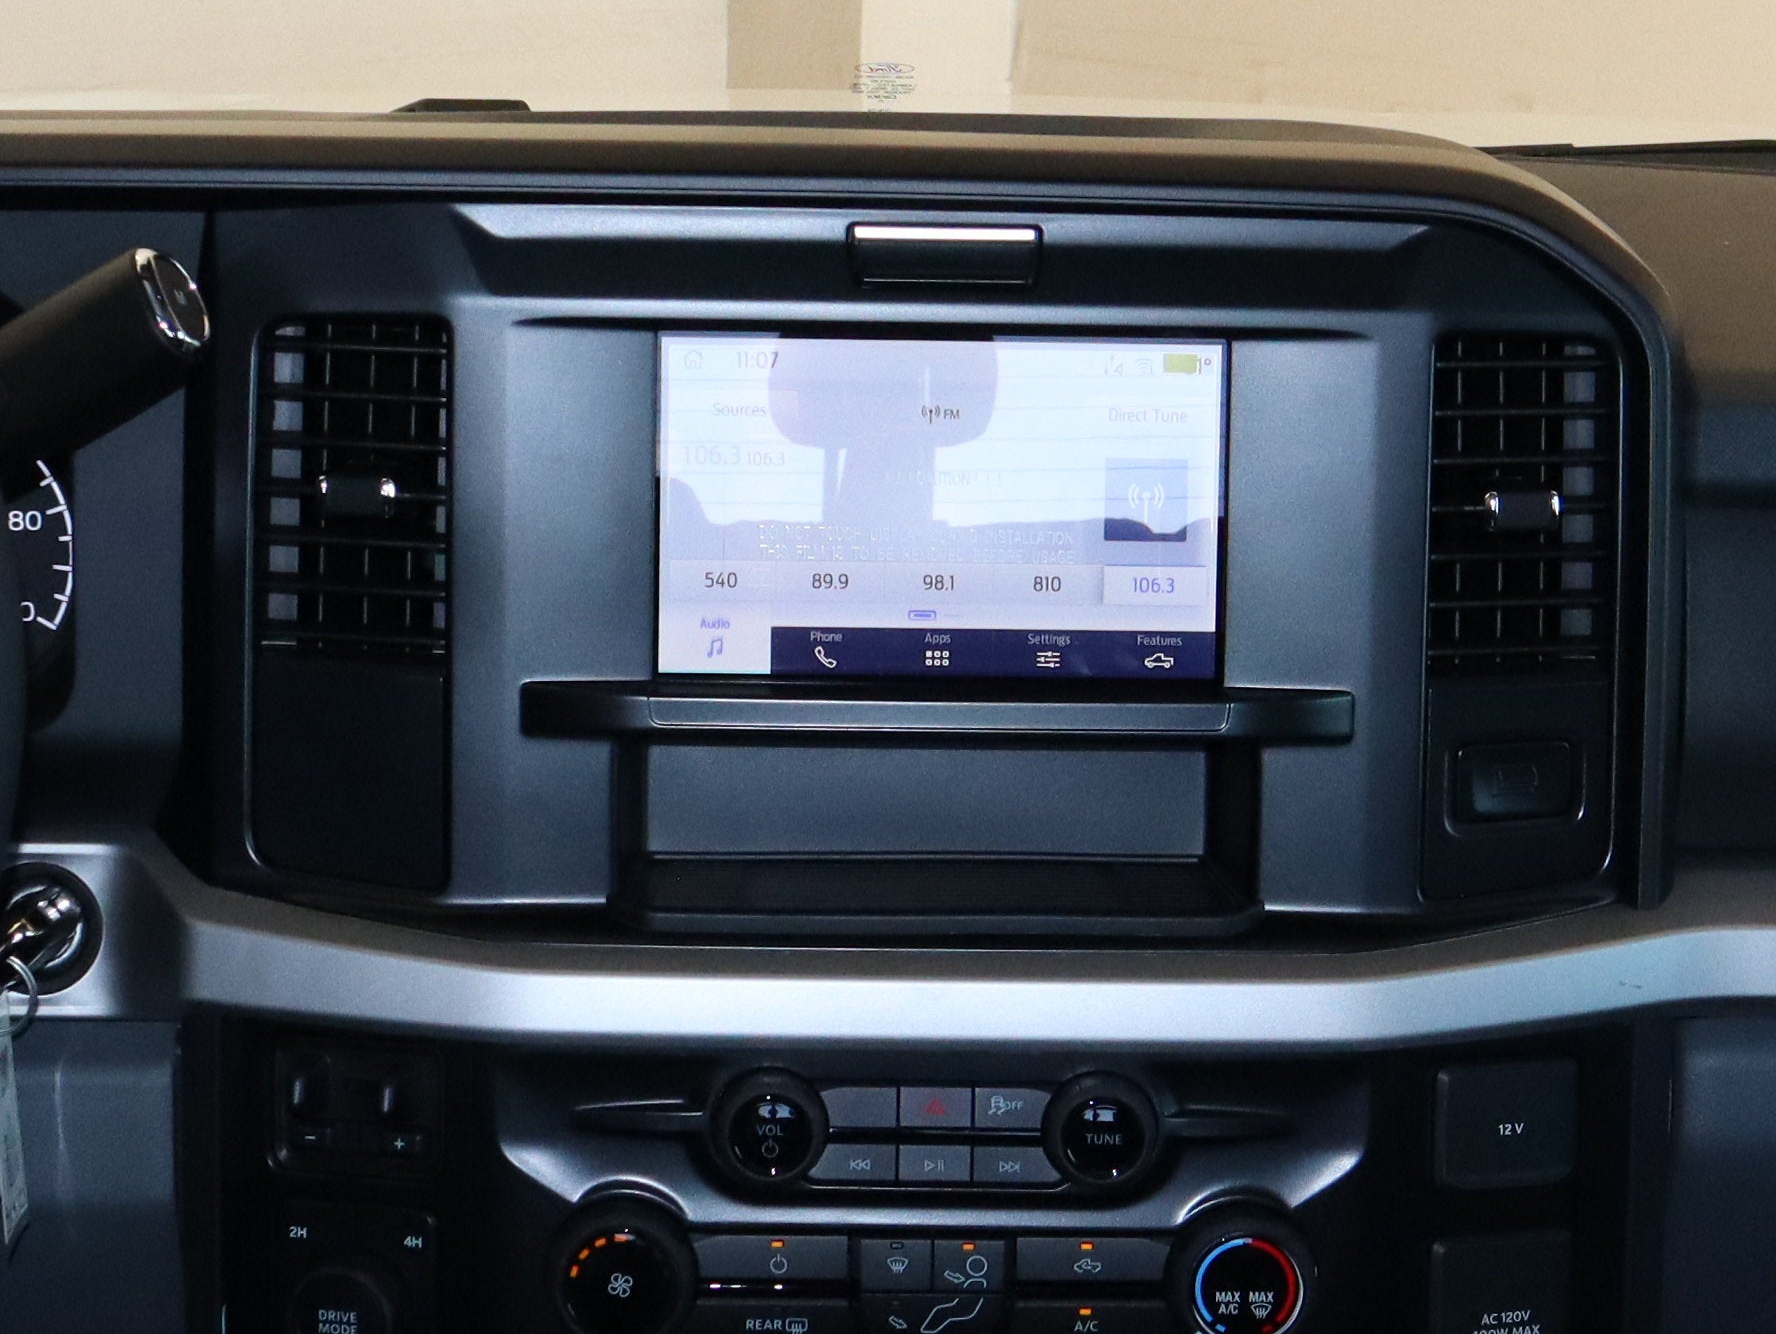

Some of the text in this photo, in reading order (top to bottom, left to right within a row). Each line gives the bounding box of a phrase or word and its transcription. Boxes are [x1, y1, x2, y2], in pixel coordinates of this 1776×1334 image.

[736, 351, 779, 369] 11:07
[712, 402, 767, 417] Sources
[943, 408, 960, 420] FM
[1108, 407, 1188, 424] Direct Tune
[683, 445, 786, 467] 106.3 106.3
[7, 510, 42, 531] 80
[1030, 549, 1073, 564] USAGE
[704, 571, 1175, 594] 540 89.9 98.1 810 106.3
[699, 616, 731, 630] Audio
[810, 630, 1183, 648] Phone Apps Settings Features
[1004, 1100, 1024, 1112] OFF
[755, 1124, 785, 1137] VOL
[1498, 1123, 1525, 1136] 12 V
[1085, 1133, 1124, 1146] TUNE
[289, 1226, 308, 1239] 2H
[403, 1236, 423, 1249] 4H
[1215, 1291, 1241, 1304] MAX
[1249, 1291, 1274, 1304] MAX
[318, 1310, 358, 1324] DRIVE
[1217, 1303, 1240, 1317] A/C
[745, 1318, 784, 1332] REAR
[1481, 1310, 1532, 1326] AC 120V
[1073, 1319, 1100, 1334] A/C
